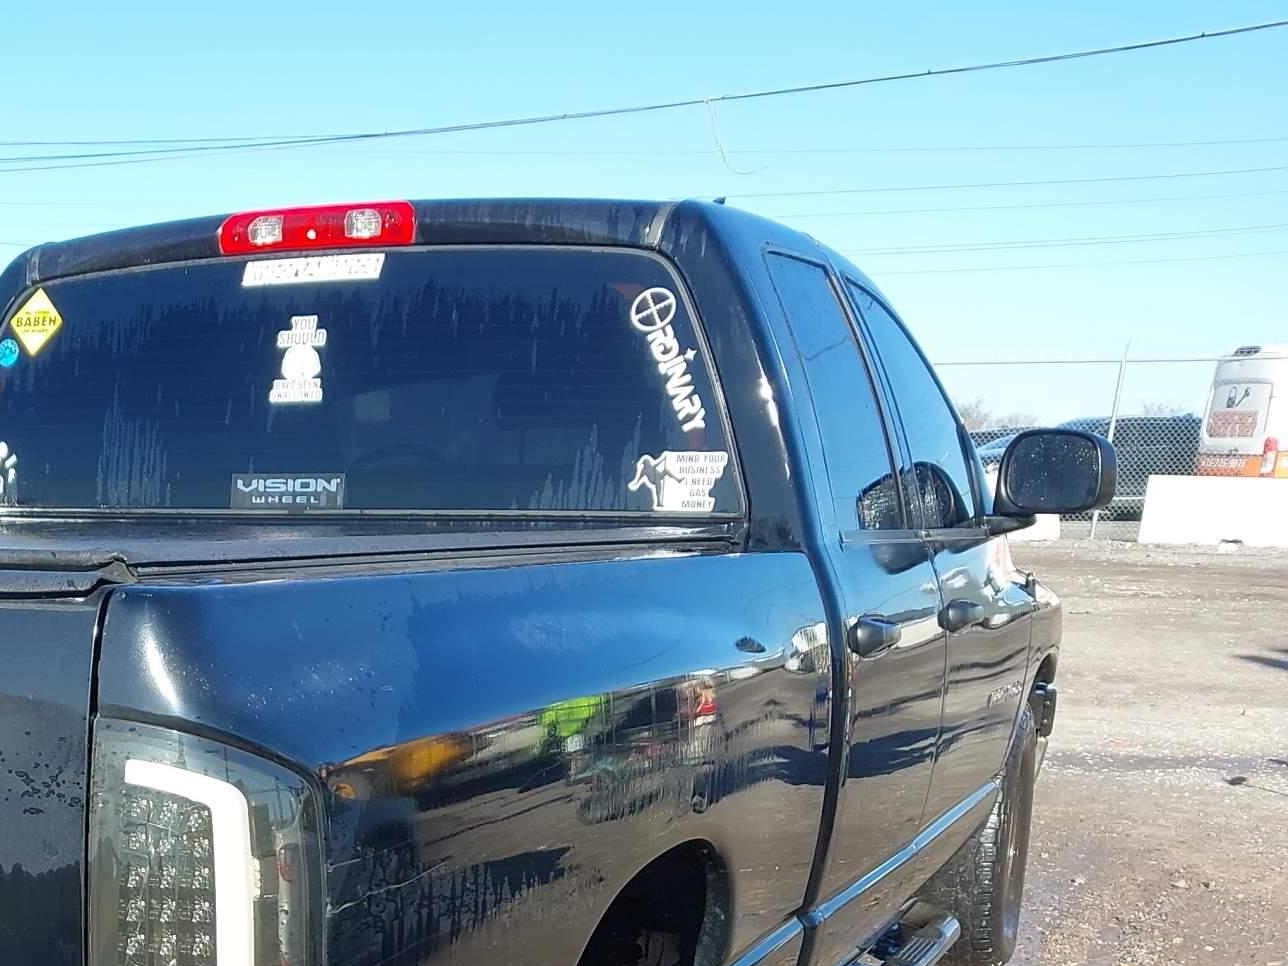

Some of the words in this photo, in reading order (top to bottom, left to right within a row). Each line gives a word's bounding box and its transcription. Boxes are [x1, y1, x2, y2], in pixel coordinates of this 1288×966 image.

[293, 317, 316, 331] YOU
[279, 331, 325, 345] SHOULD
[676, 454, 700, 463] MIND
[703, 454, 726, 463] YOUR
[678, 465, 721, 474] BUSINESS
[237, 478, 338, 493] VISION
[691, 477, 713, 486] NEED
[689, 488, 706, 497] GAS
[252, 495, 319, 504] WHEEL
[681, 499, 713, 509] MONEY
